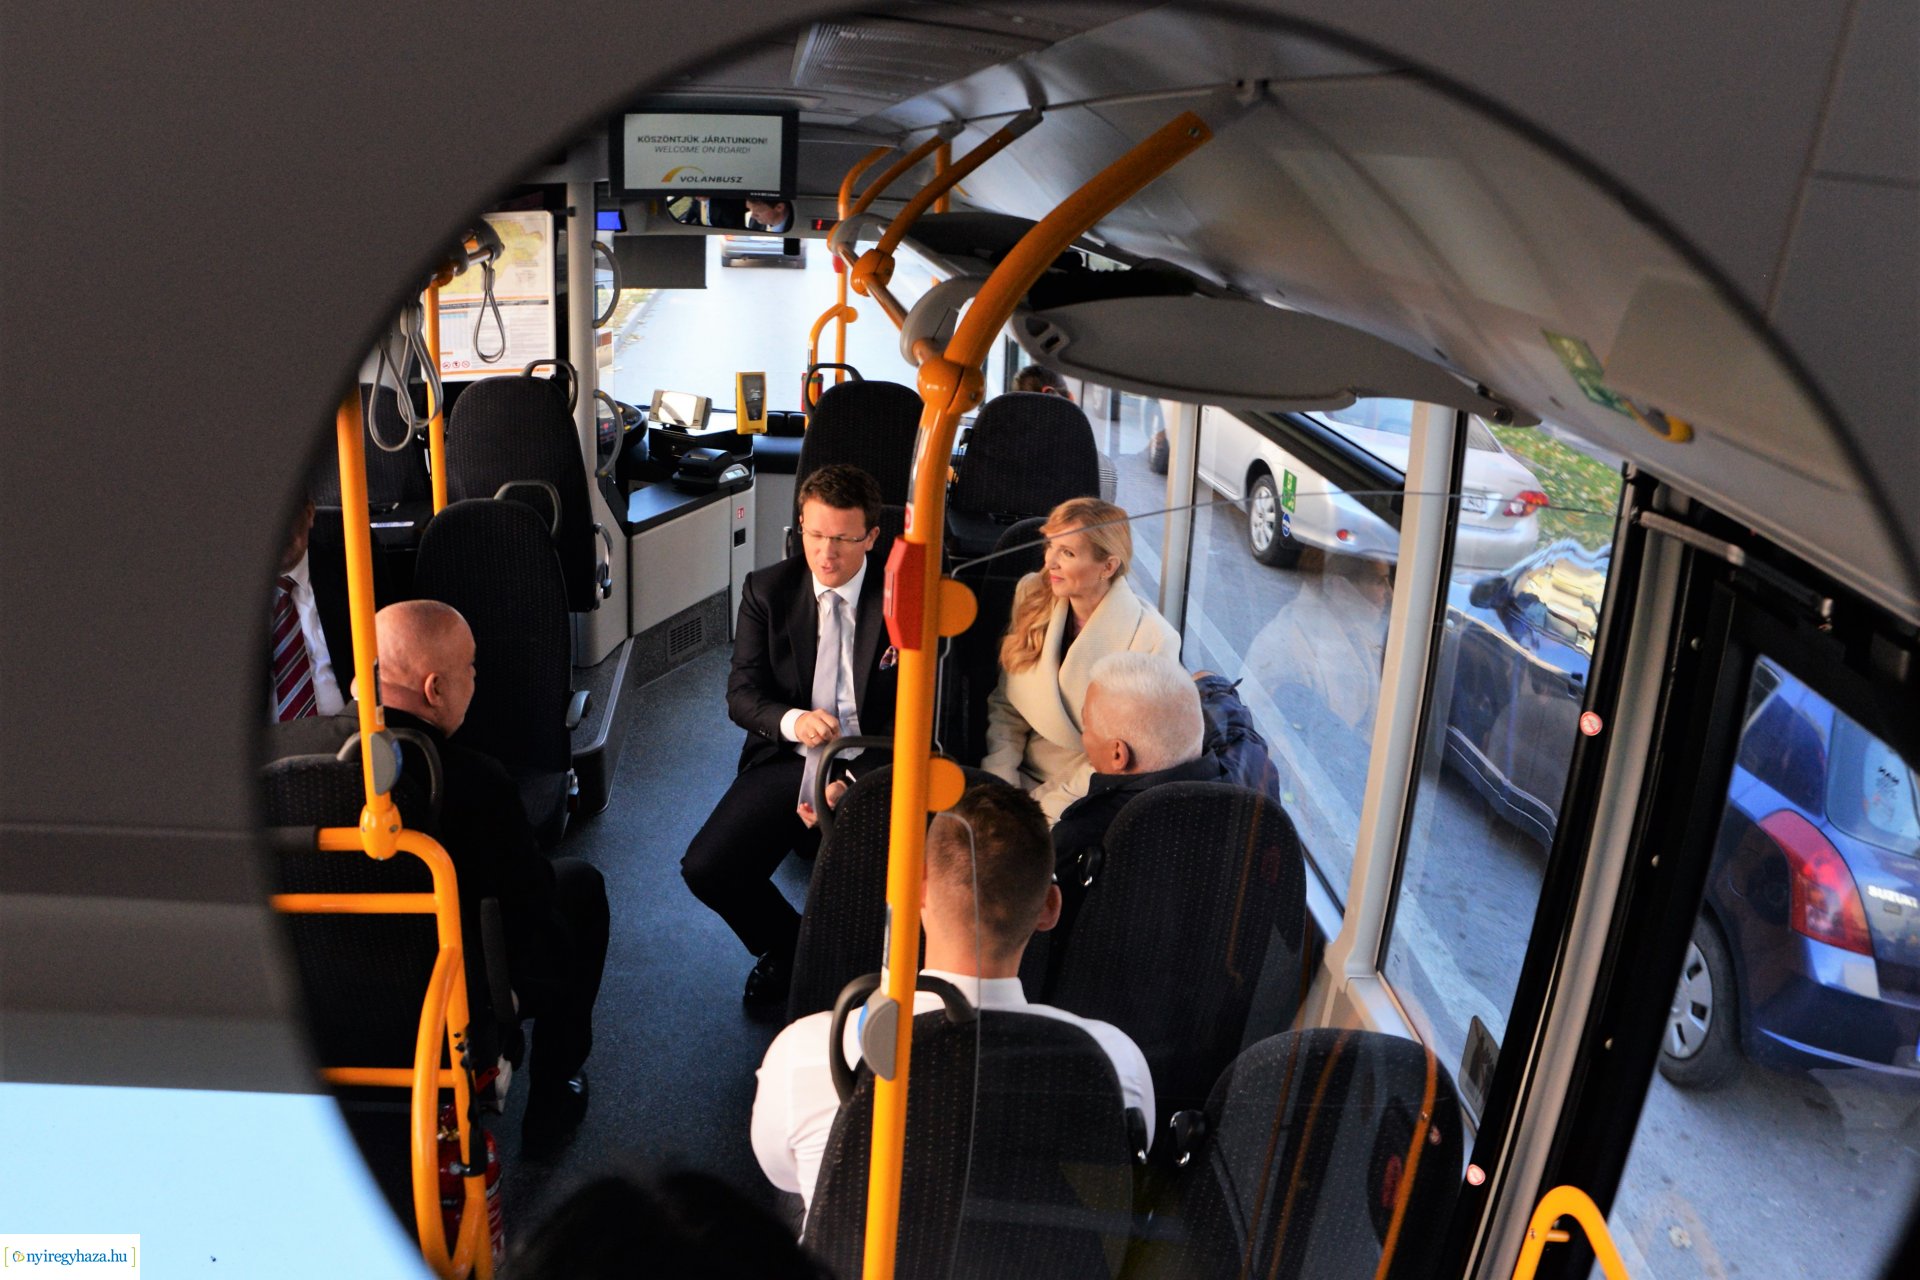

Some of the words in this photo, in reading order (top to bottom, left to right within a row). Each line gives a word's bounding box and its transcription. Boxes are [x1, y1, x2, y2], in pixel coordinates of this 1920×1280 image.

[637, 134, 699, 144] KÖSZÖNTJÜK
[701, 134, 768, 145] JÁRATUNKON!
[655, 145, 700, 154] WELCOME
[702, 146, 715, 154] ON
[717, 146, 751, 154] BOARD!
